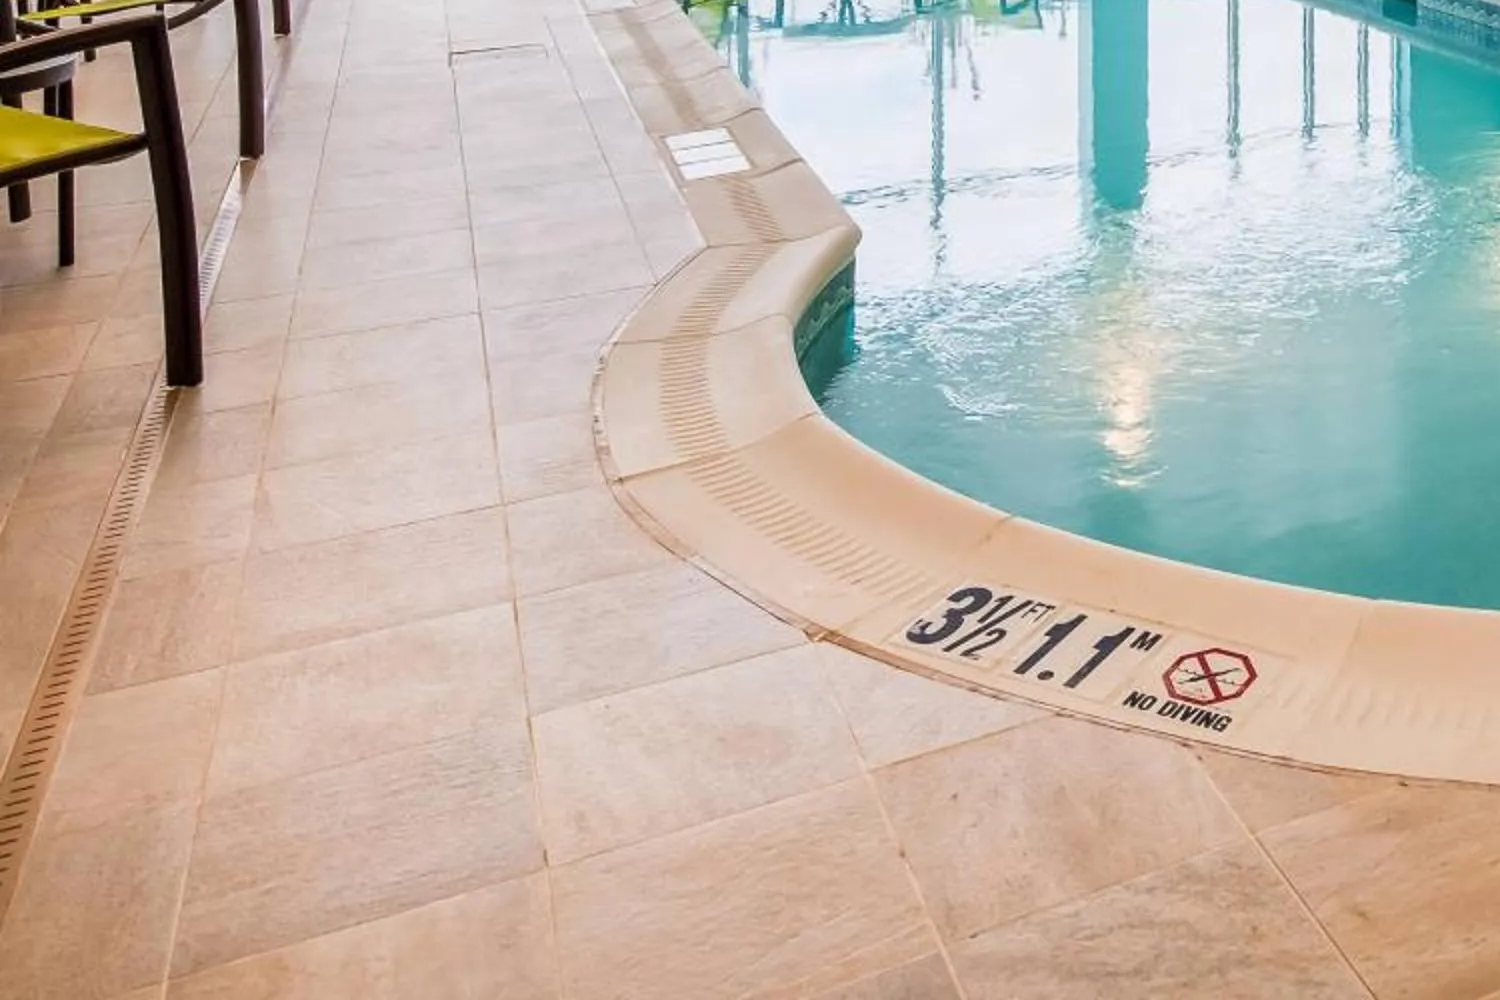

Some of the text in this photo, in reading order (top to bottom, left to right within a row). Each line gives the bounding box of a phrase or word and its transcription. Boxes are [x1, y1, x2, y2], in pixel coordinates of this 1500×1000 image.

[1020, 601, 1056, 624] FT
[1012, 613, 1136, 689] 1.1
[1130, 630, 1163, 652] M
[1122, 690, 1233, 733] NO DIVING
